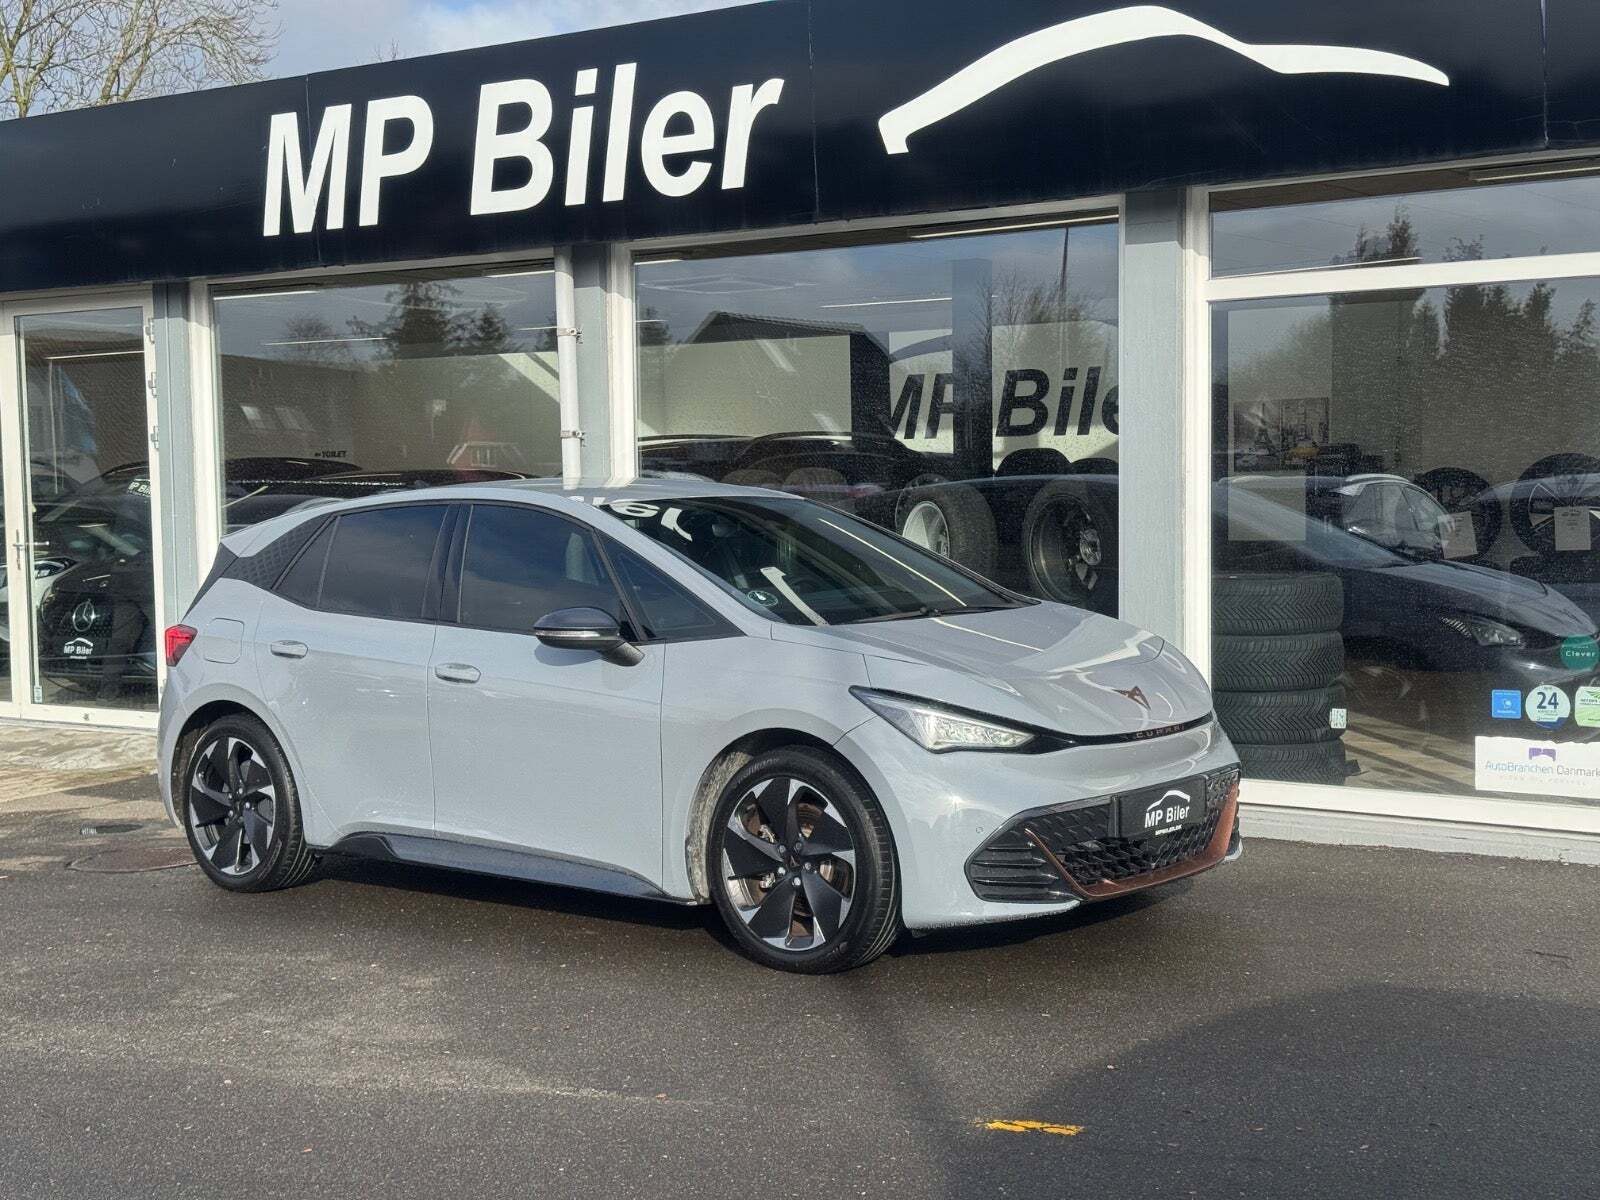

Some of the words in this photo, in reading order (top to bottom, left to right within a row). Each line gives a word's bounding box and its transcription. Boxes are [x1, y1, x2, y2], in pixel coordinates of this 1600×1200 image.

[263, 94, 434, 236] MP
[470, 62, 785, 215] Biler
[1536, 691, 1559, 710] 24
[1485, 760, 1554, 774] AutoBranchen
[1144, 808, 1163, 829] MP
[1166, 804, 1190, 824] Biler
